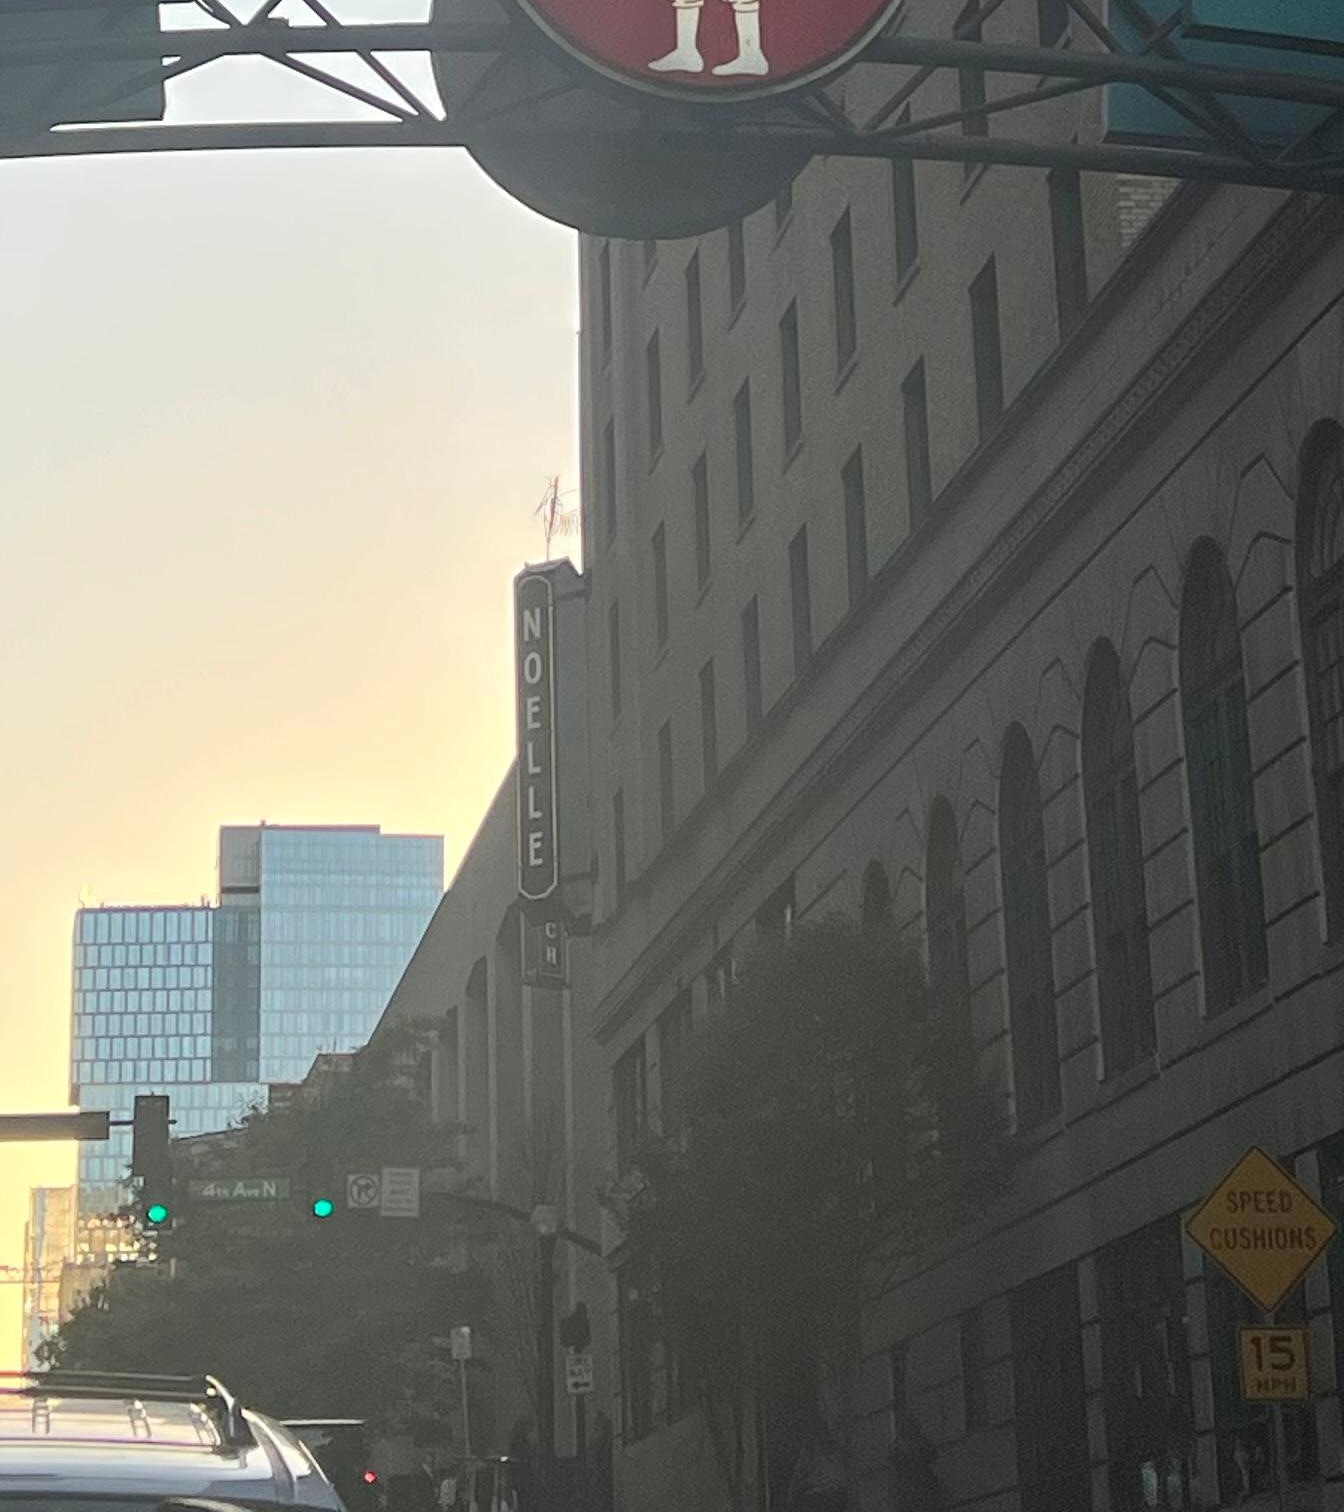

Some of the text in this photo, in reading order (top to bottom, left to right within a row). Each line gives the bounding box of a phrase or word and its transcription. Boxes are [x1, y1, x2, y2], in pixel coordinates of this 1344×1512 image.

[522, 607, 543, 867] NOELLE
[262, 1180, 277, 1197] N
[1226, 1190, 1293, 1214] SPEED
[1210, 1226, 1318, 1251] CUSHIONS
[1250, 1335, 1296, 1372] 15
[1256, 1377, 1297, 1394] MPH
